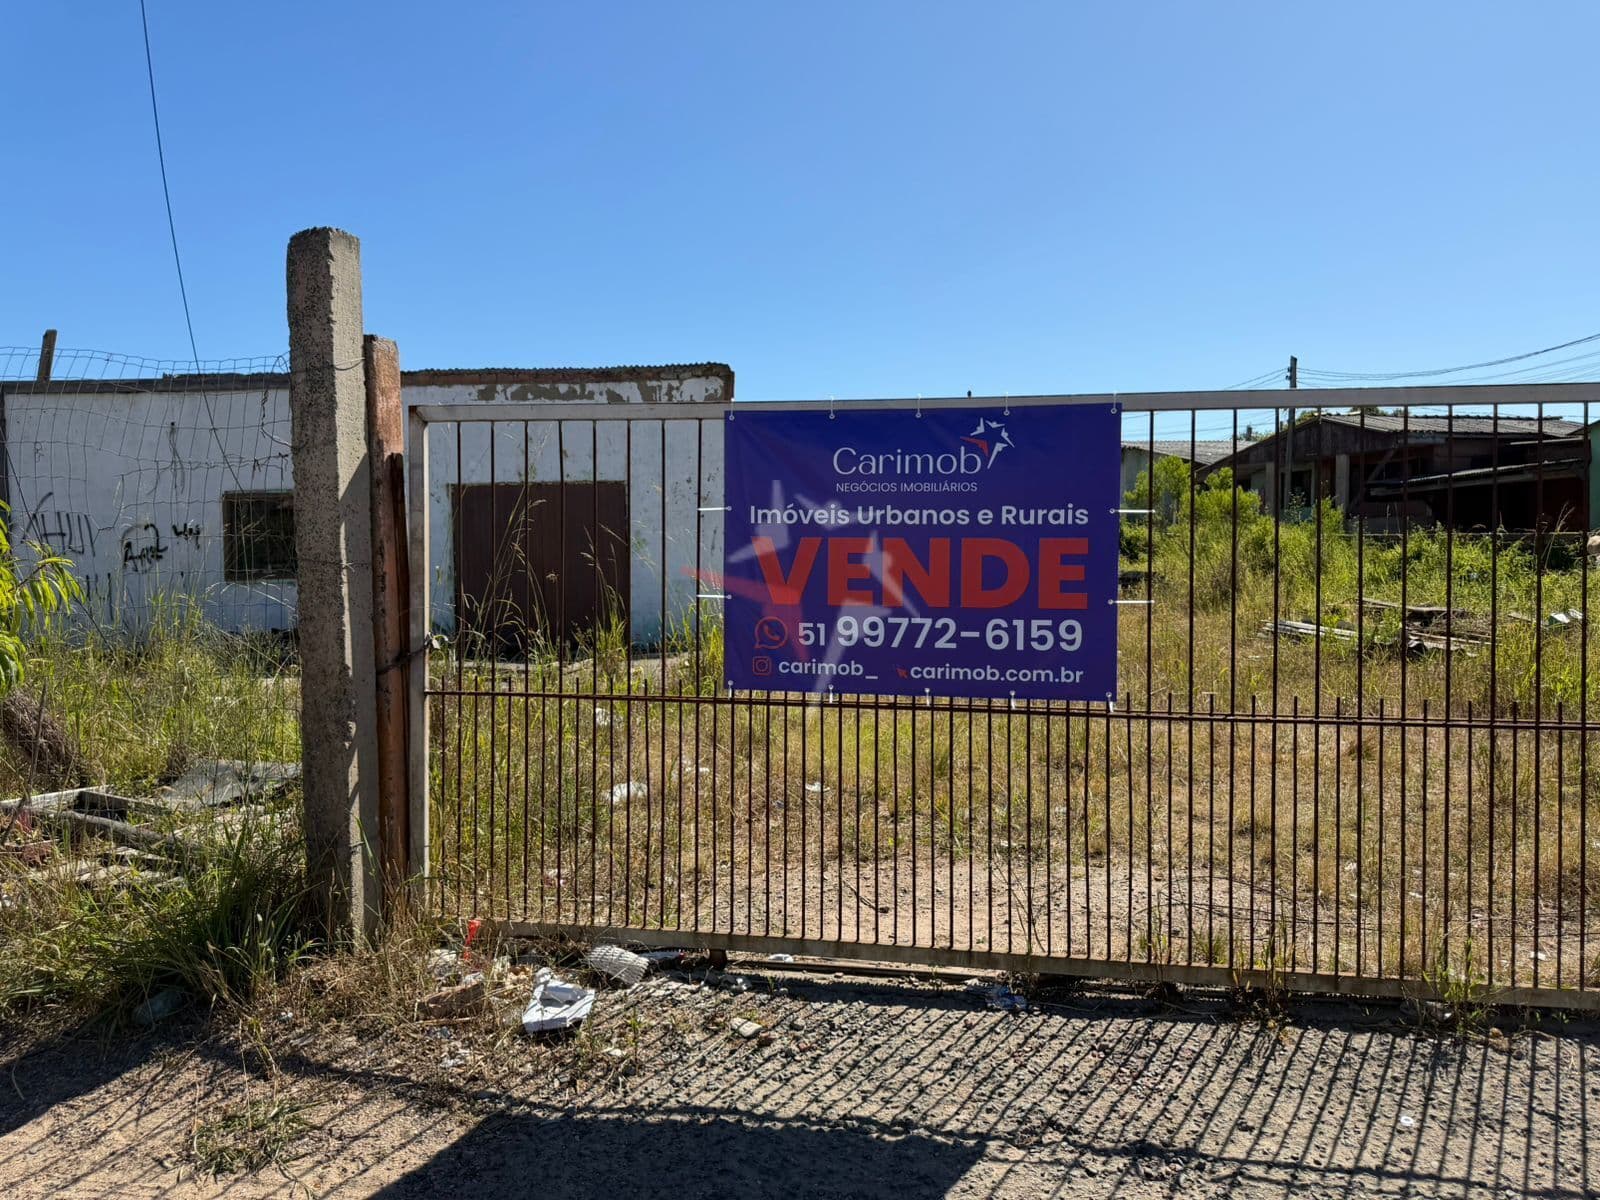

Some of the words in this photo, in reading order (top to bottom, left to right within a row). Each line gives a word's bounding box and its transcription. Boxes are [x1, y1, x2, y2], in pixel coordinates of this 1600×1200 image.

[833, 446, 982, 475] Carimob
[836, 481, 897, 493] NEGÓCIOS
[900, 481, 978, 493] IMOBILIÁRIOS
[750, 504, 850, 525] Imóveis
[857, 505, 970, 525] Urbanos
[977, 510, 994, 525] e
[1001, 504, 1089, 526] Rurais
[750, 536, 1089, 610] VENDE
[798, 623, 826, 647] 51
[836, 615, 1083, 651] 99772-6159
[778, 658, 878, 680] carimob_
[910, 663, 1084, 683] carimob.com.br
